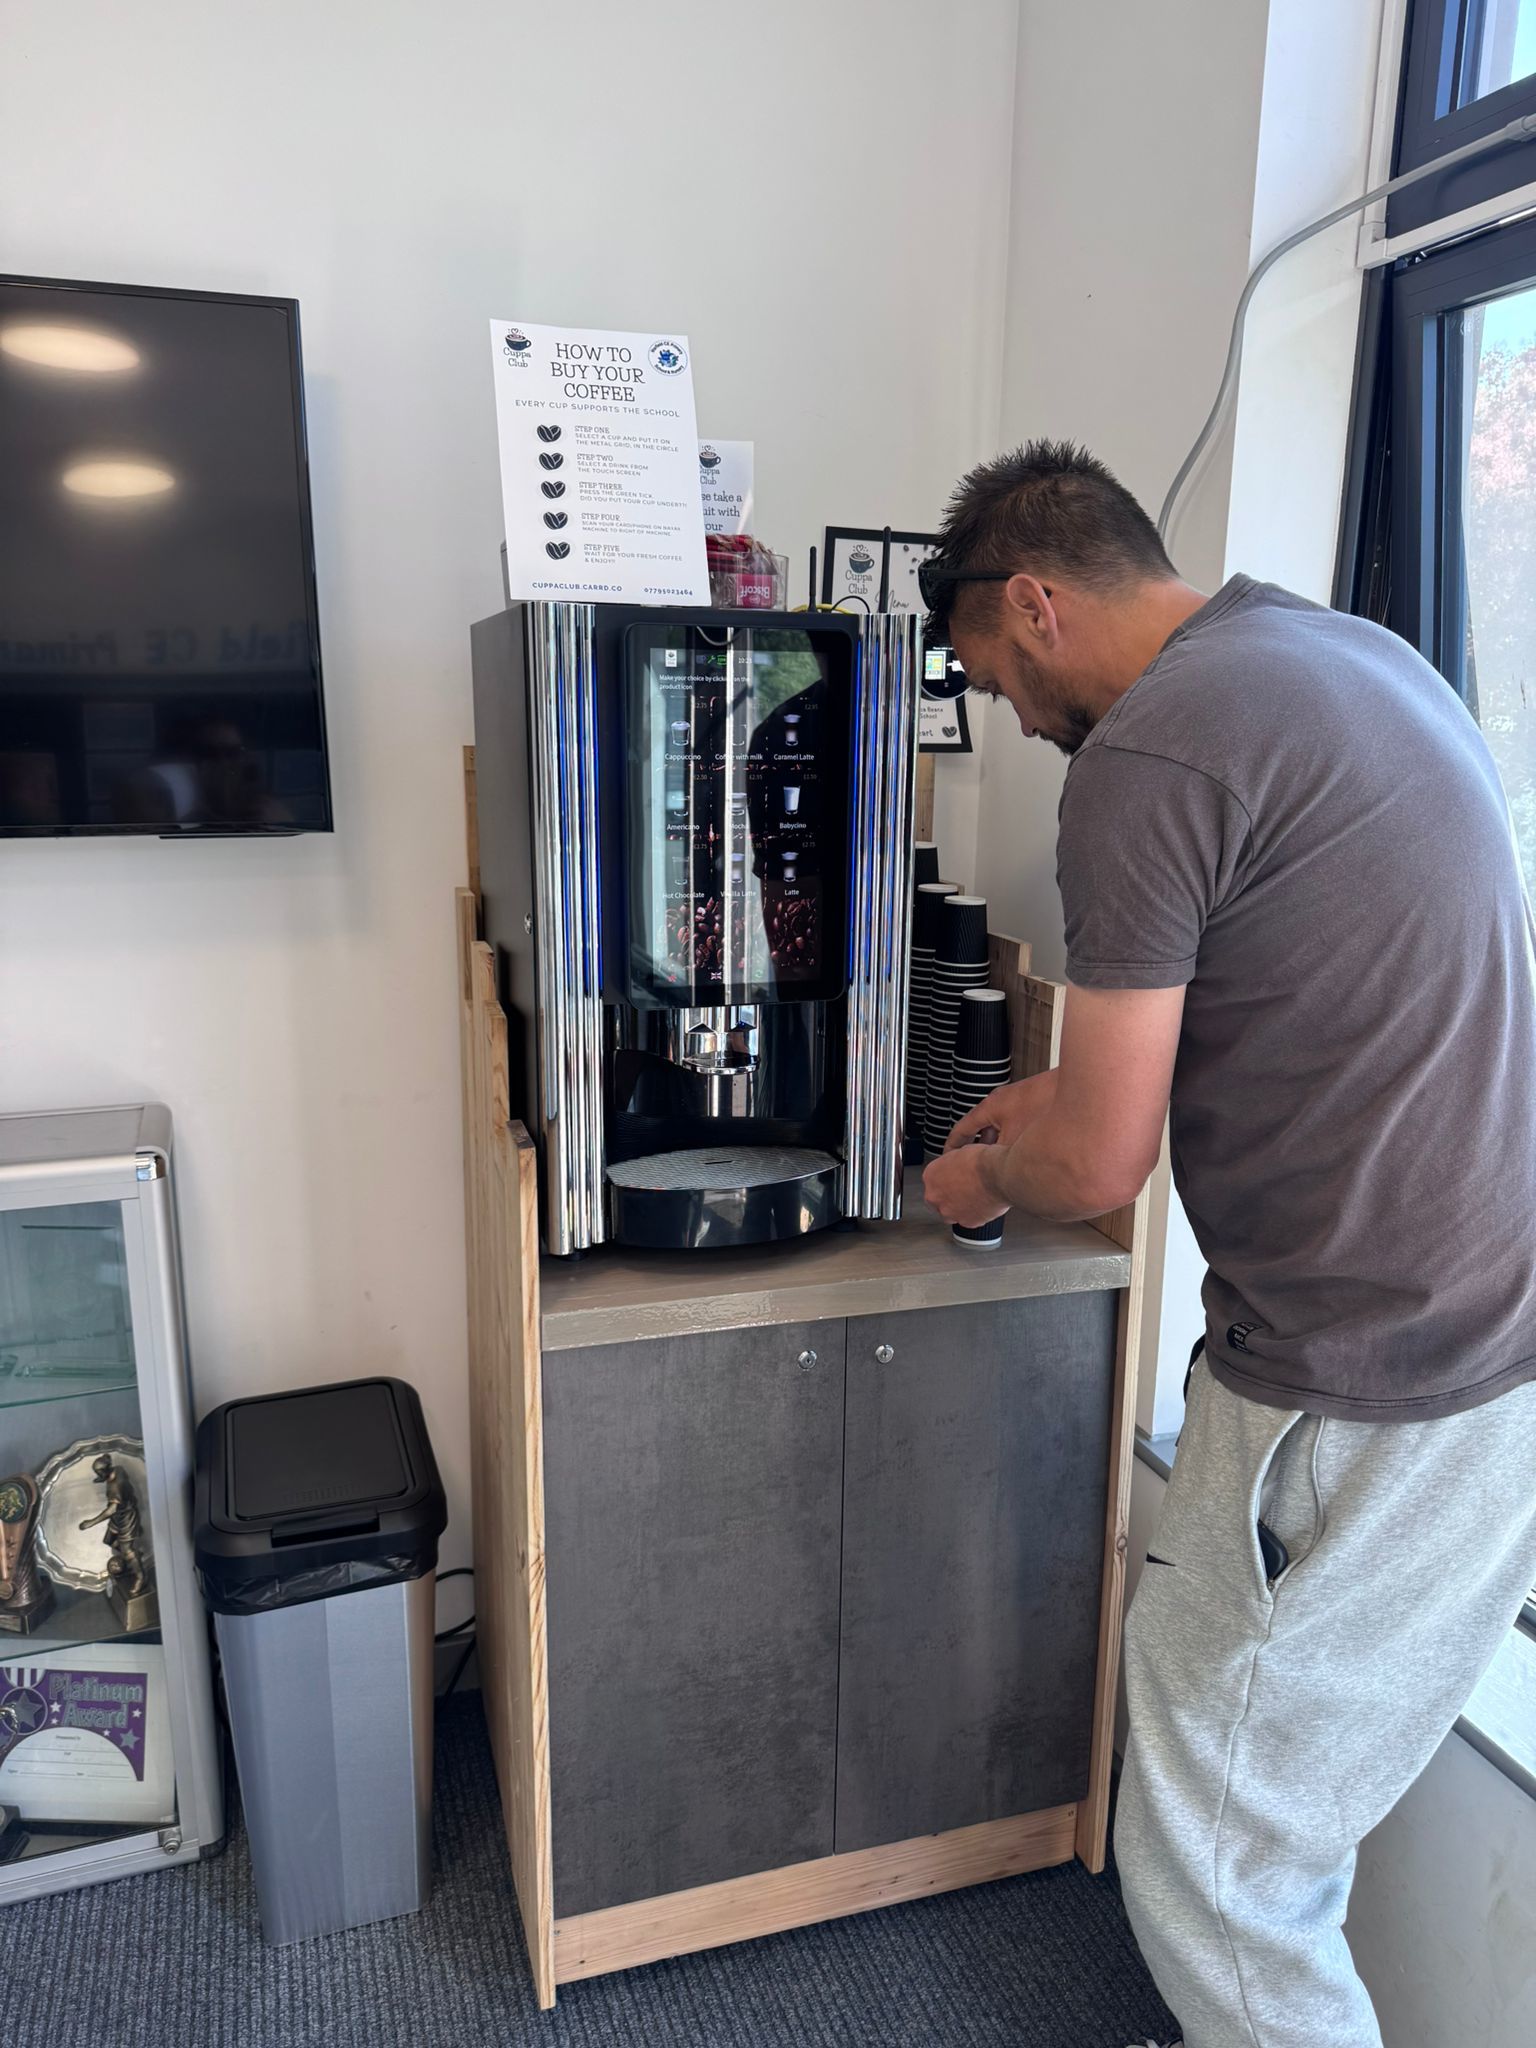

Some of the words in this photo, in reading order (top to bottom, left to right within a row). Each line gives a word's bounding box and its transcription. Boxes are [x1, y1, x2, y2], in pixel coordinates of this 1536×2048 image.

[503, 347, 532, 358] Cuppa
[555, 343, 603, 361] HOW
[606, 347, 632, 362] TO
[508, 358, 528, 368] Club
[550, 362, 589, 379] BUY
[592, 366, 646, 384] YOUR
[564, 382, 635, 402] COFFEE
[515, 400, 546, 408] EVERY
[549, 401, 568, 409] CUP
[571, 403, 620, 413] SUPPORTS
[623, 406, 640, 415] THE
[643, 408, 680, 418] SCHOOL
[700, 476, 717, 485] Club
[714, 490, 734, 502] take
[718, 506, 740, 517] with
[845, 570, 872, 583] Cuppa
[532, 582, 623, 592] CUPPACLUB.CARRD.CO
[740, 586, 770, 599] Biscoff
[848, 583, 868, 594] Club
[50, 1672, 144, 1702] Platinum
[62, 1701, 129, 1728] Award
